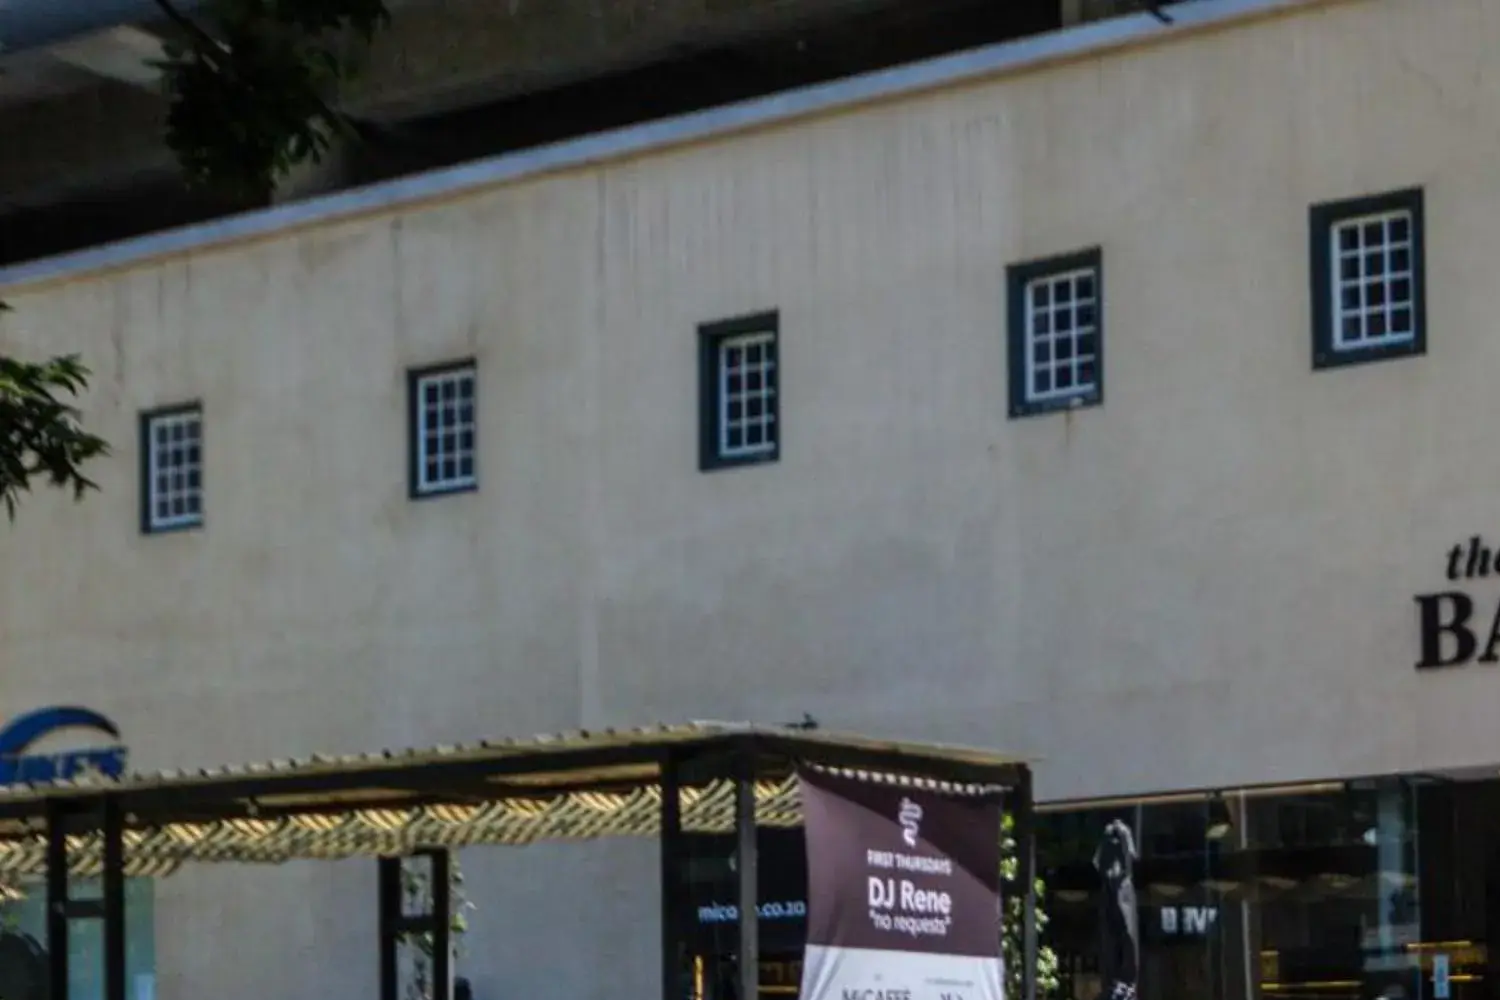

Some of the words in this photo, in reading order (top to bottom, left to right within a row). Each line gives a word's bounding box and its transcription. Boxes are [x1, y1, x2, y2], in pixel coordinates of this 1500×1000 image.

[867, 848, 893, 867] FIRST
[868, 877, 894, 909] DJ
[900, 880, 952, 914] Rene
